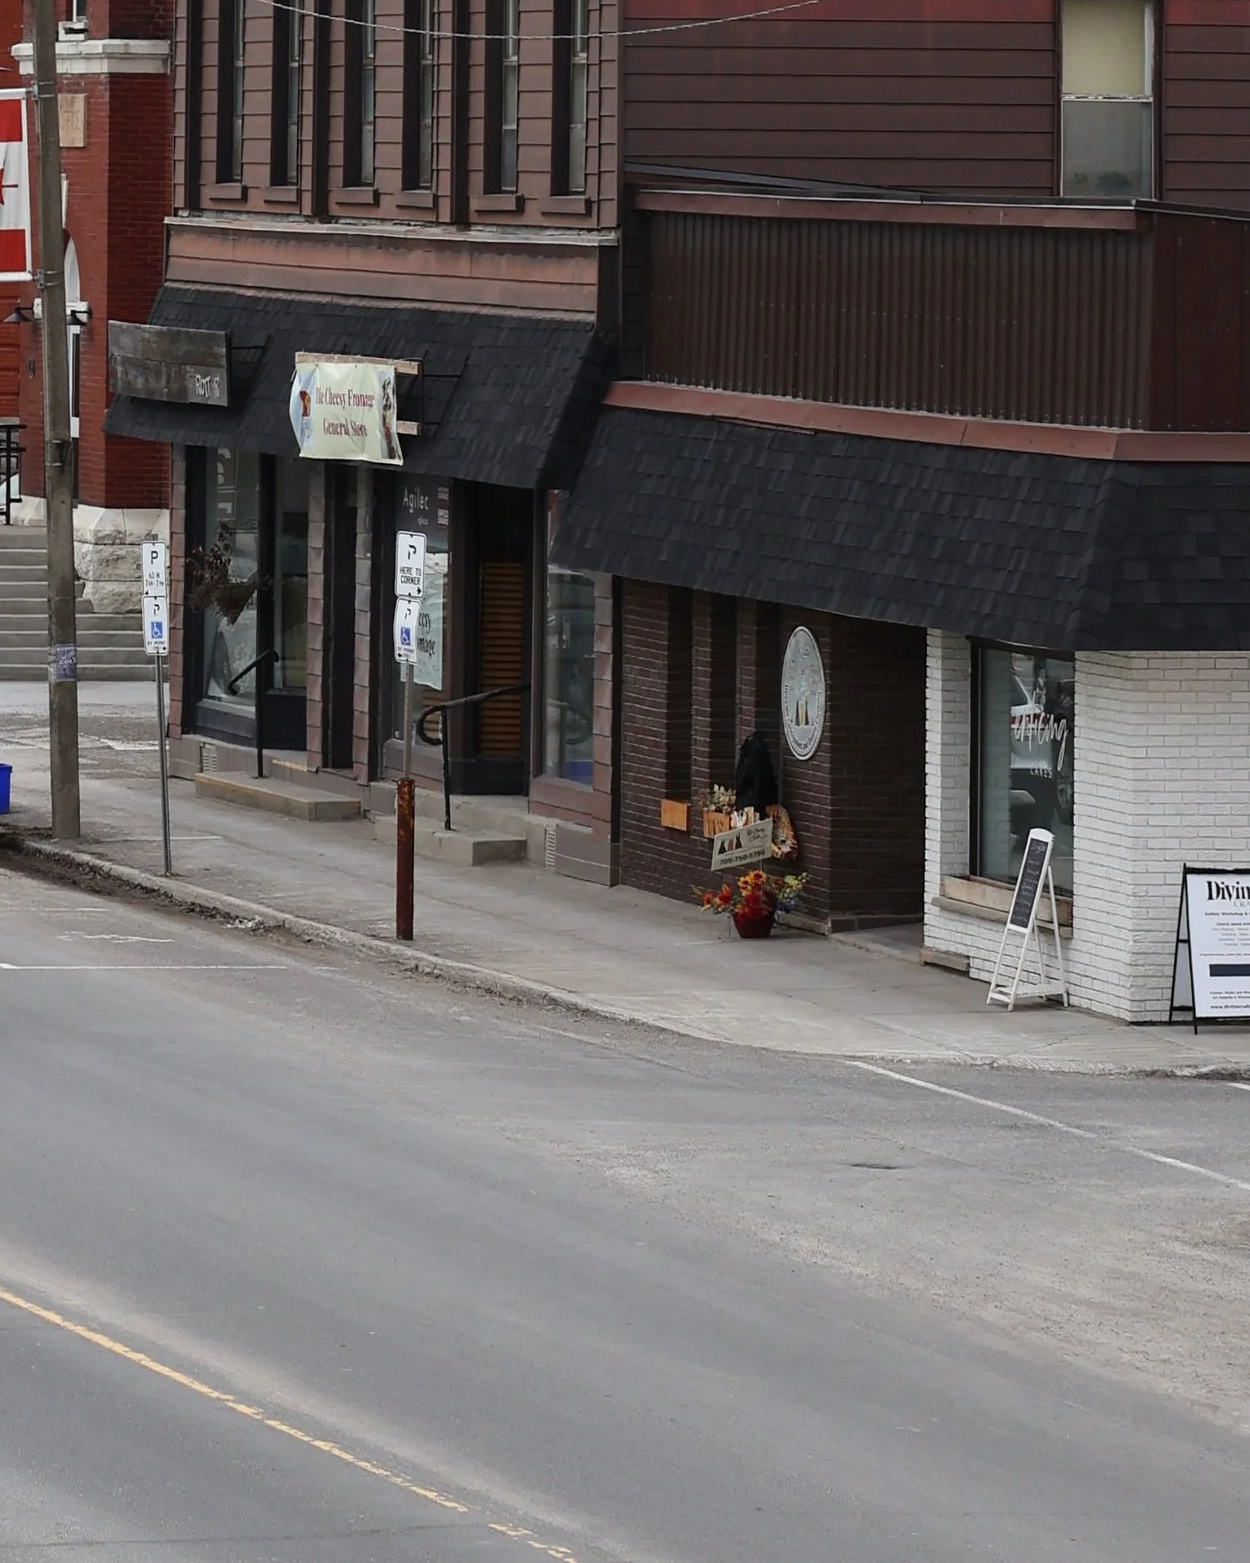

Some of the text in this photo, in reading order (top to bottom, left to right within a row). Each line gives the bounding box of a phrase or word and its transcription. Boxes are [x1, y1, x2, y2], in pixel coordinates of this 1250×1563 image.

[324, 386, 346, 410] Cheesy
[347, 389, 375, 411] Fromage
[323, 417, 368, 437] General Store
[402, 485, 430, 513] Agilec
[399, 566, 422, 576] HERE TO
[400, 575, 421, 585] CORNER
